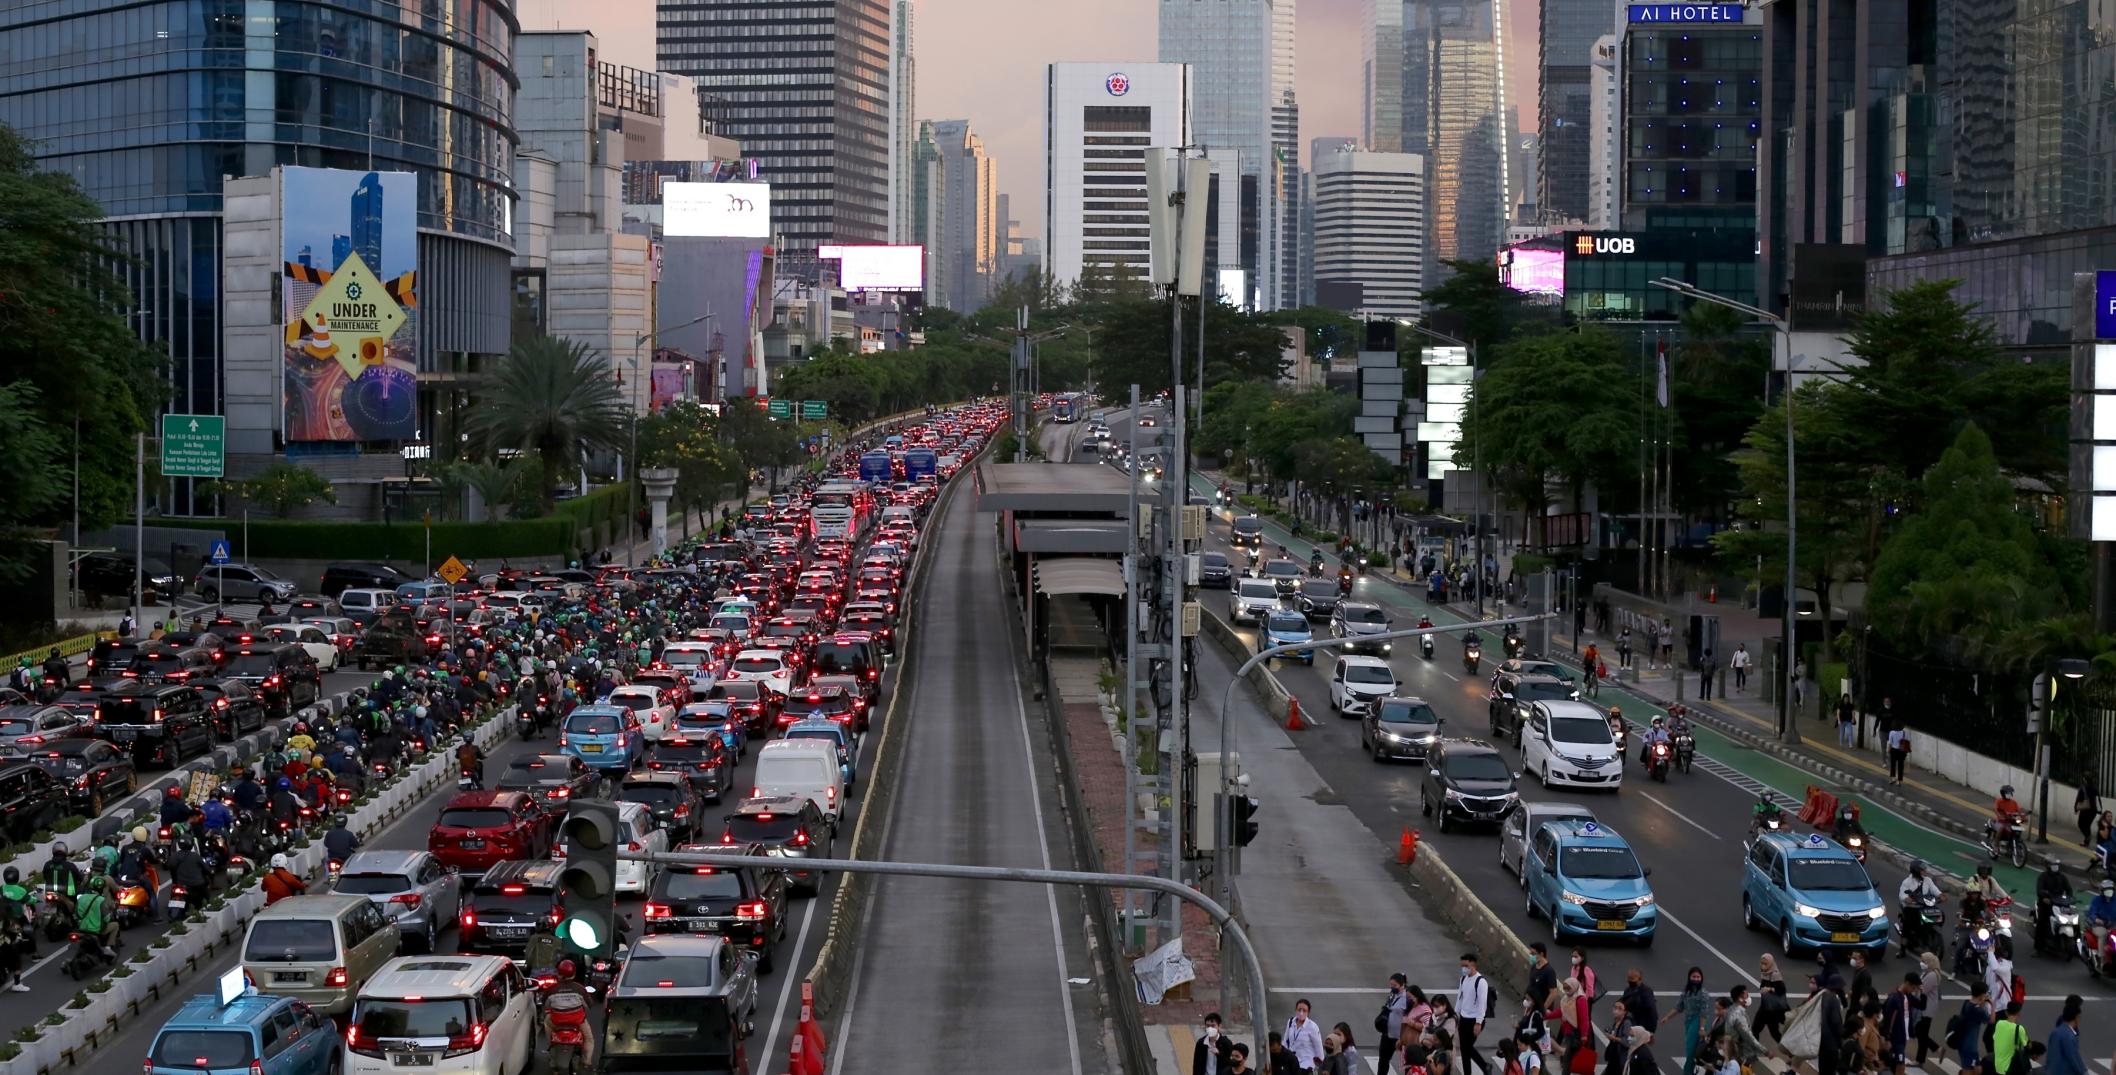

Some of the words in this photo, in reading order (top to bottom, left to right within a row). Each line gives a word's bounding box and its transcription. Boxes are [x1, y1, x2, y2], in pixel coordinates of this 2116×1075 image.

[1671, 7, 1730, 20] HOTEL
[1596, 237, 1635, 254] UOB
[333, 303, 376, 318] UNDER
[331, 321, 378, 330] MAINTENANCE
